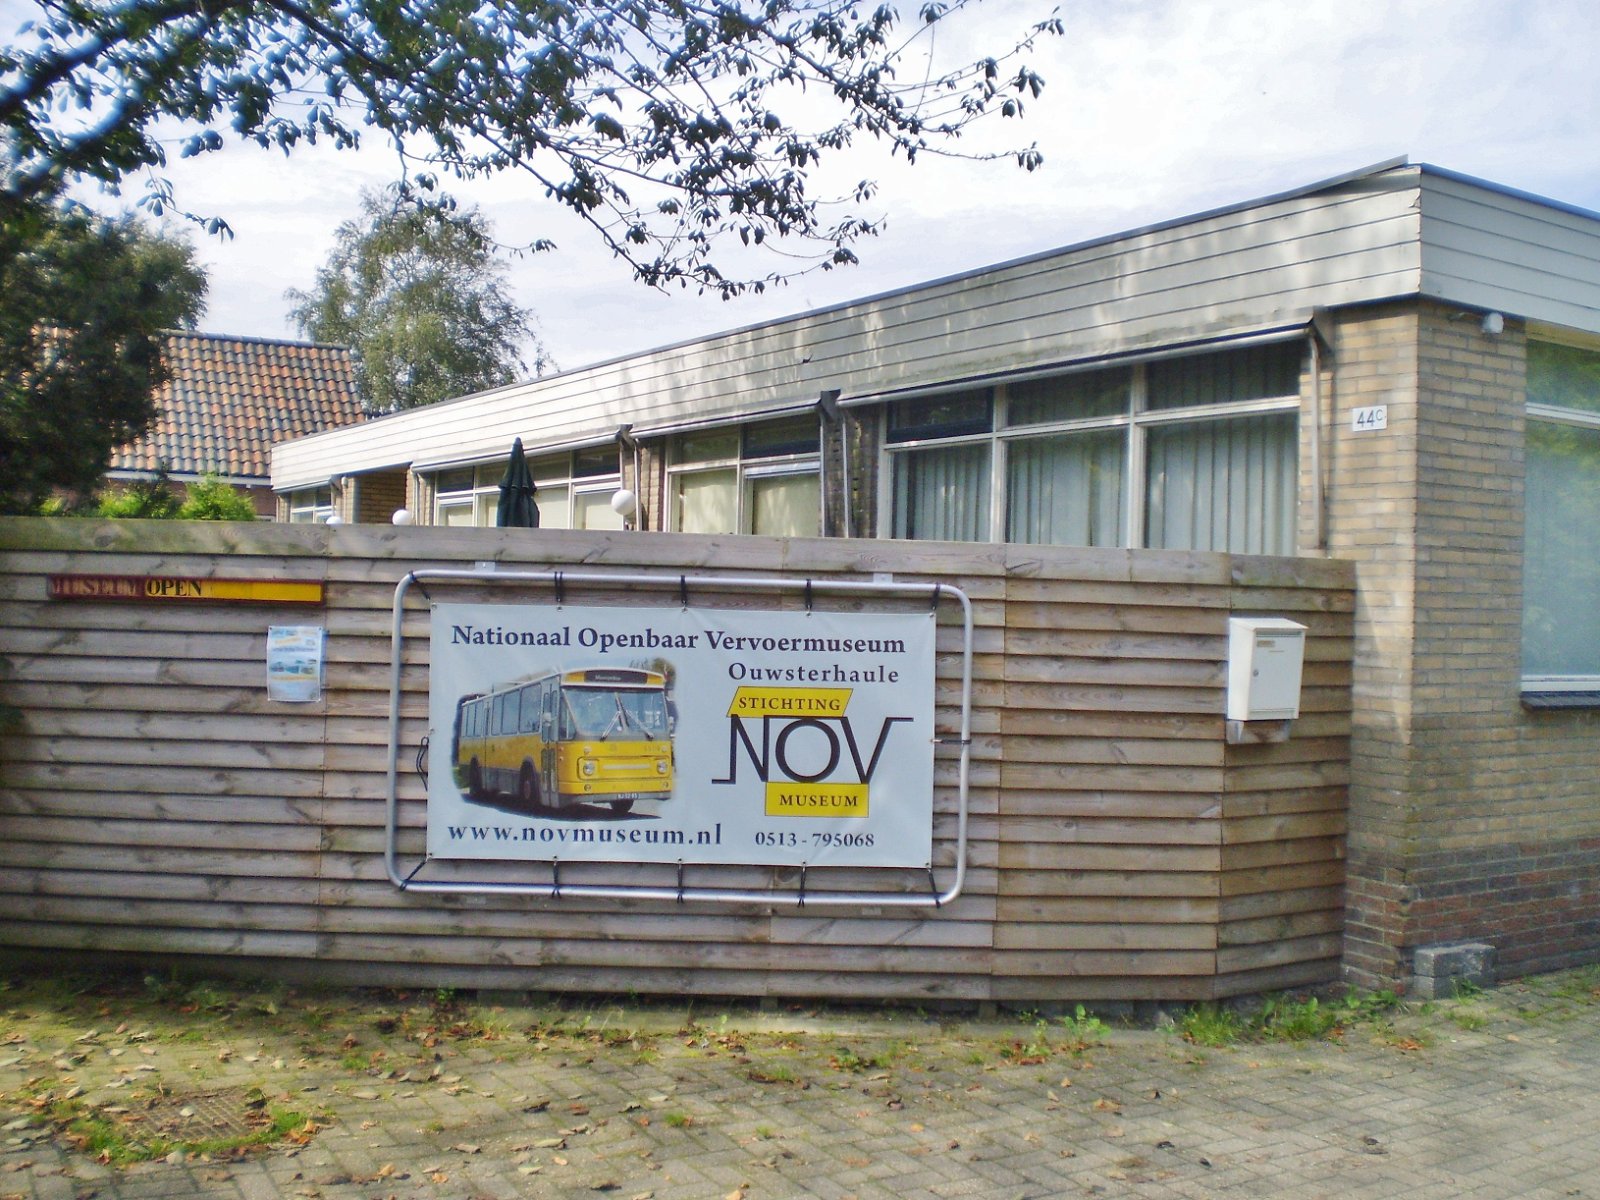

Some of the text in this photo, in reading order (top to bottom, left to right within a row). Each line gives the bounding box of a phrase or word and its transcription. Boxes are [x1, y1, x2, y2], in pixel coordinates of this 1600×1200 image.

[146, 578, 202, 597] OPEN
[451, 625, 906, 653] Nationaal Openbaar Vervoermuseum
[728, 662, 899, 683] Ouwsterhaule
[738, 696, 841, 711] STICHTING
[711, 713, 914, 784] NOV
[779, 794, 858, 807] MUSEUM
[448, 823, 722, 845] www.novmuseum.nl
